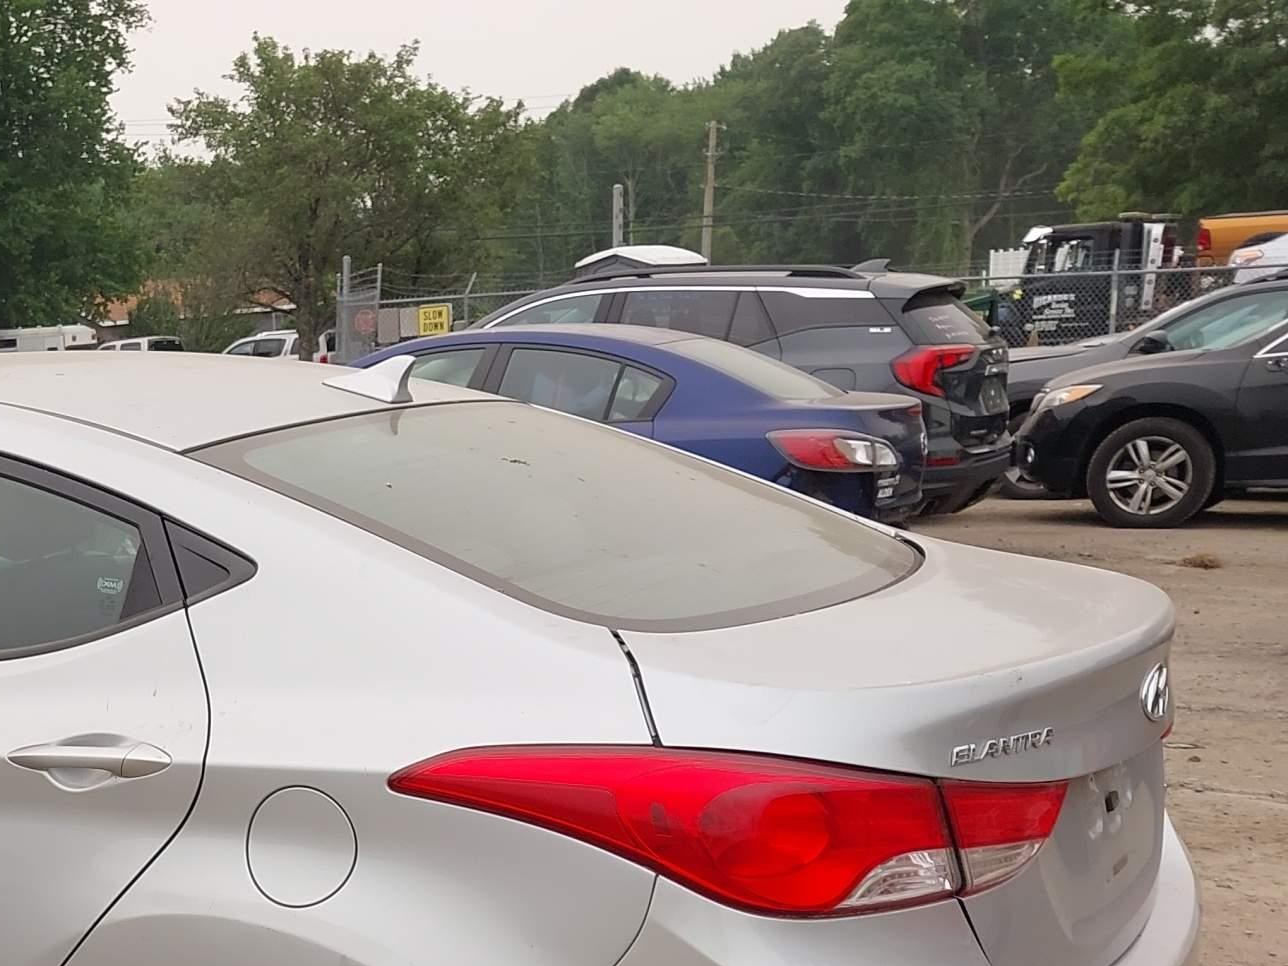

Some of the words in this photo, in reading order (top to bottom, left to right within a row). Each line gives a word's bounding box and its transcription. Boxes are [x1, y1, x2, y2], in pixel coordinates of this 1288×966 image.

[423, 309, 444, 321] SLOW
[423, 321, 445, 332] DOWN
[950, 726, 1054, 768] ELANTRA
